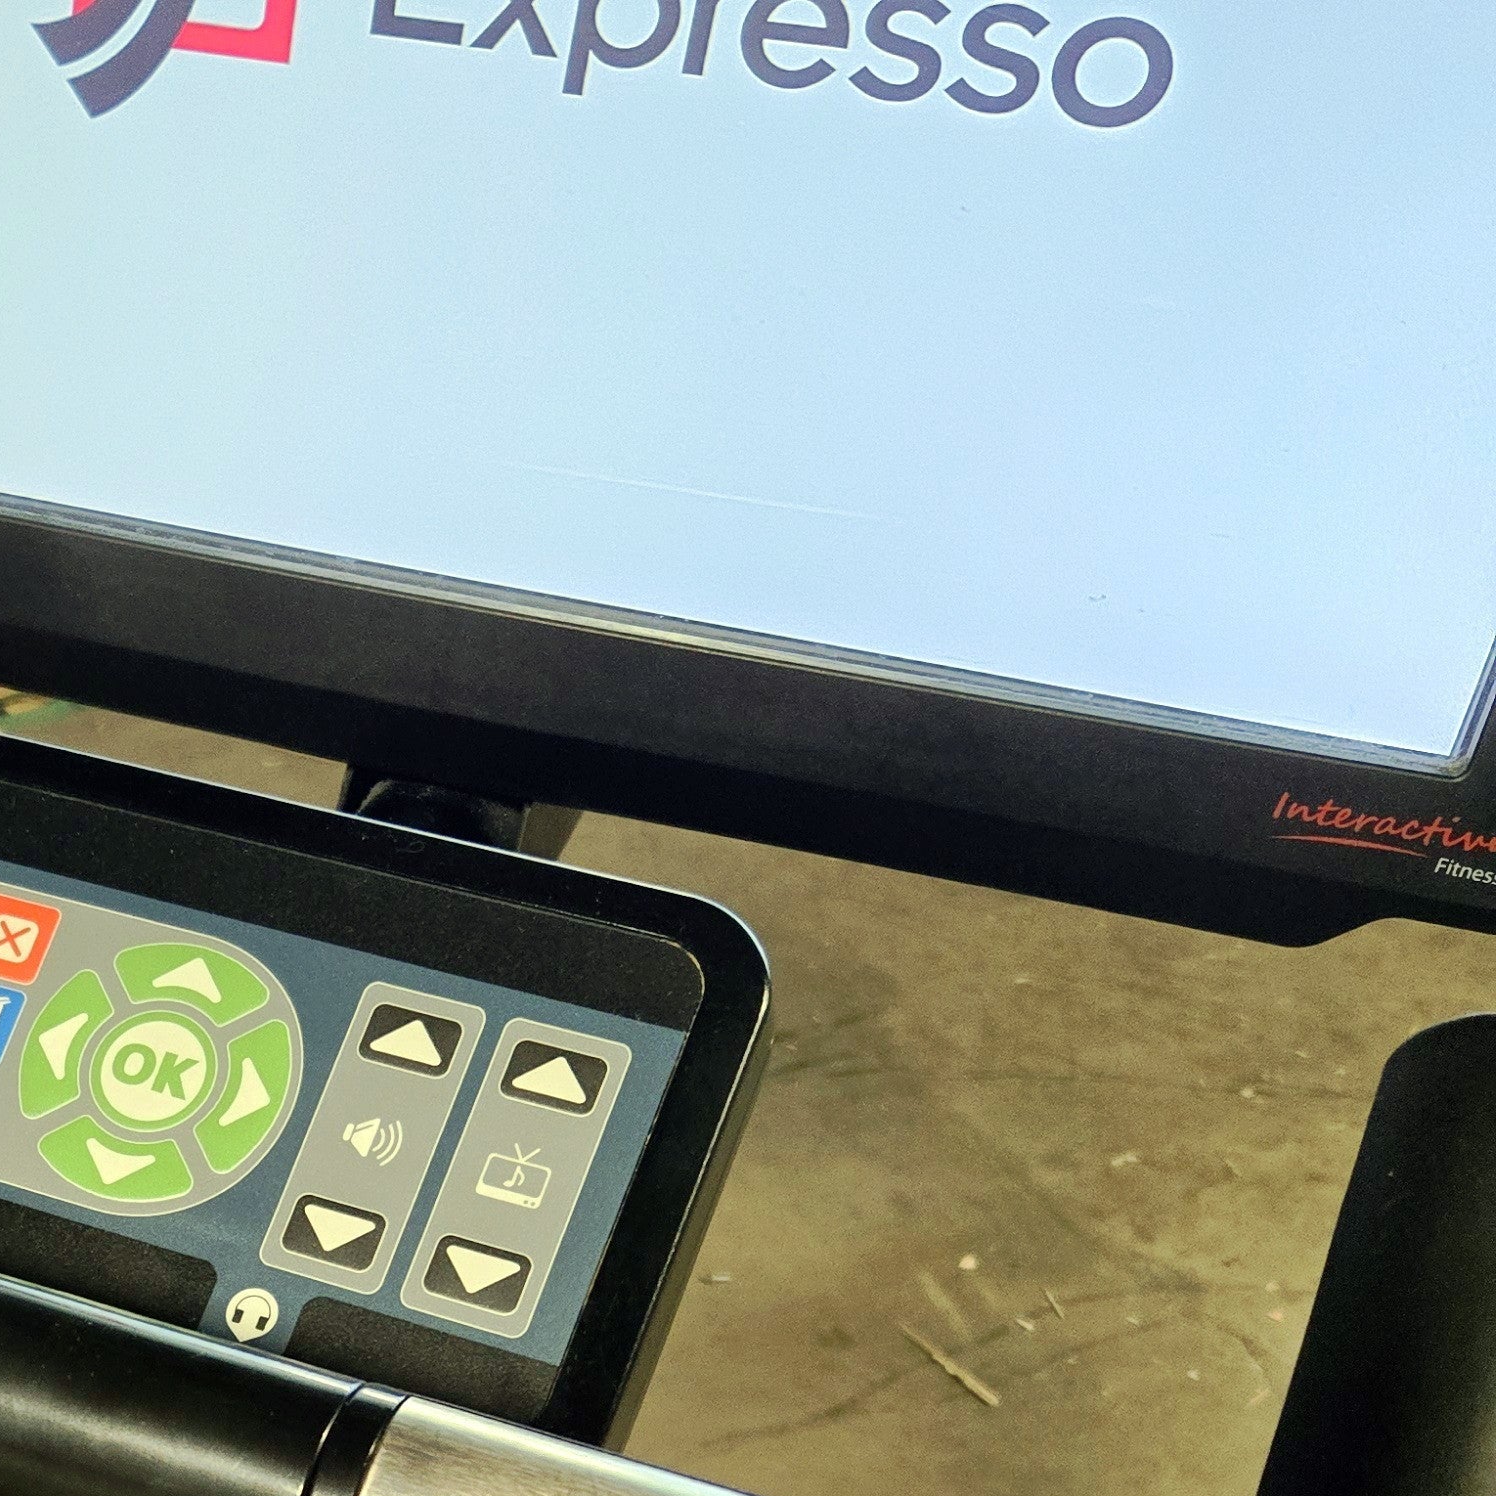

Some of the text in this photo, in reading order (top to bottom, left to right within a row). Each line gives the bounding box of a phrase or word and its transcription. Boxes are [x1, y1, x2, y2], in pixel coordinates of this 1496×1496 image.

[370, 0, 1173, 127] xpresso
[1434, 857, 1496, 886] Fitnes
[112, 1043, 200, 1101] OK
